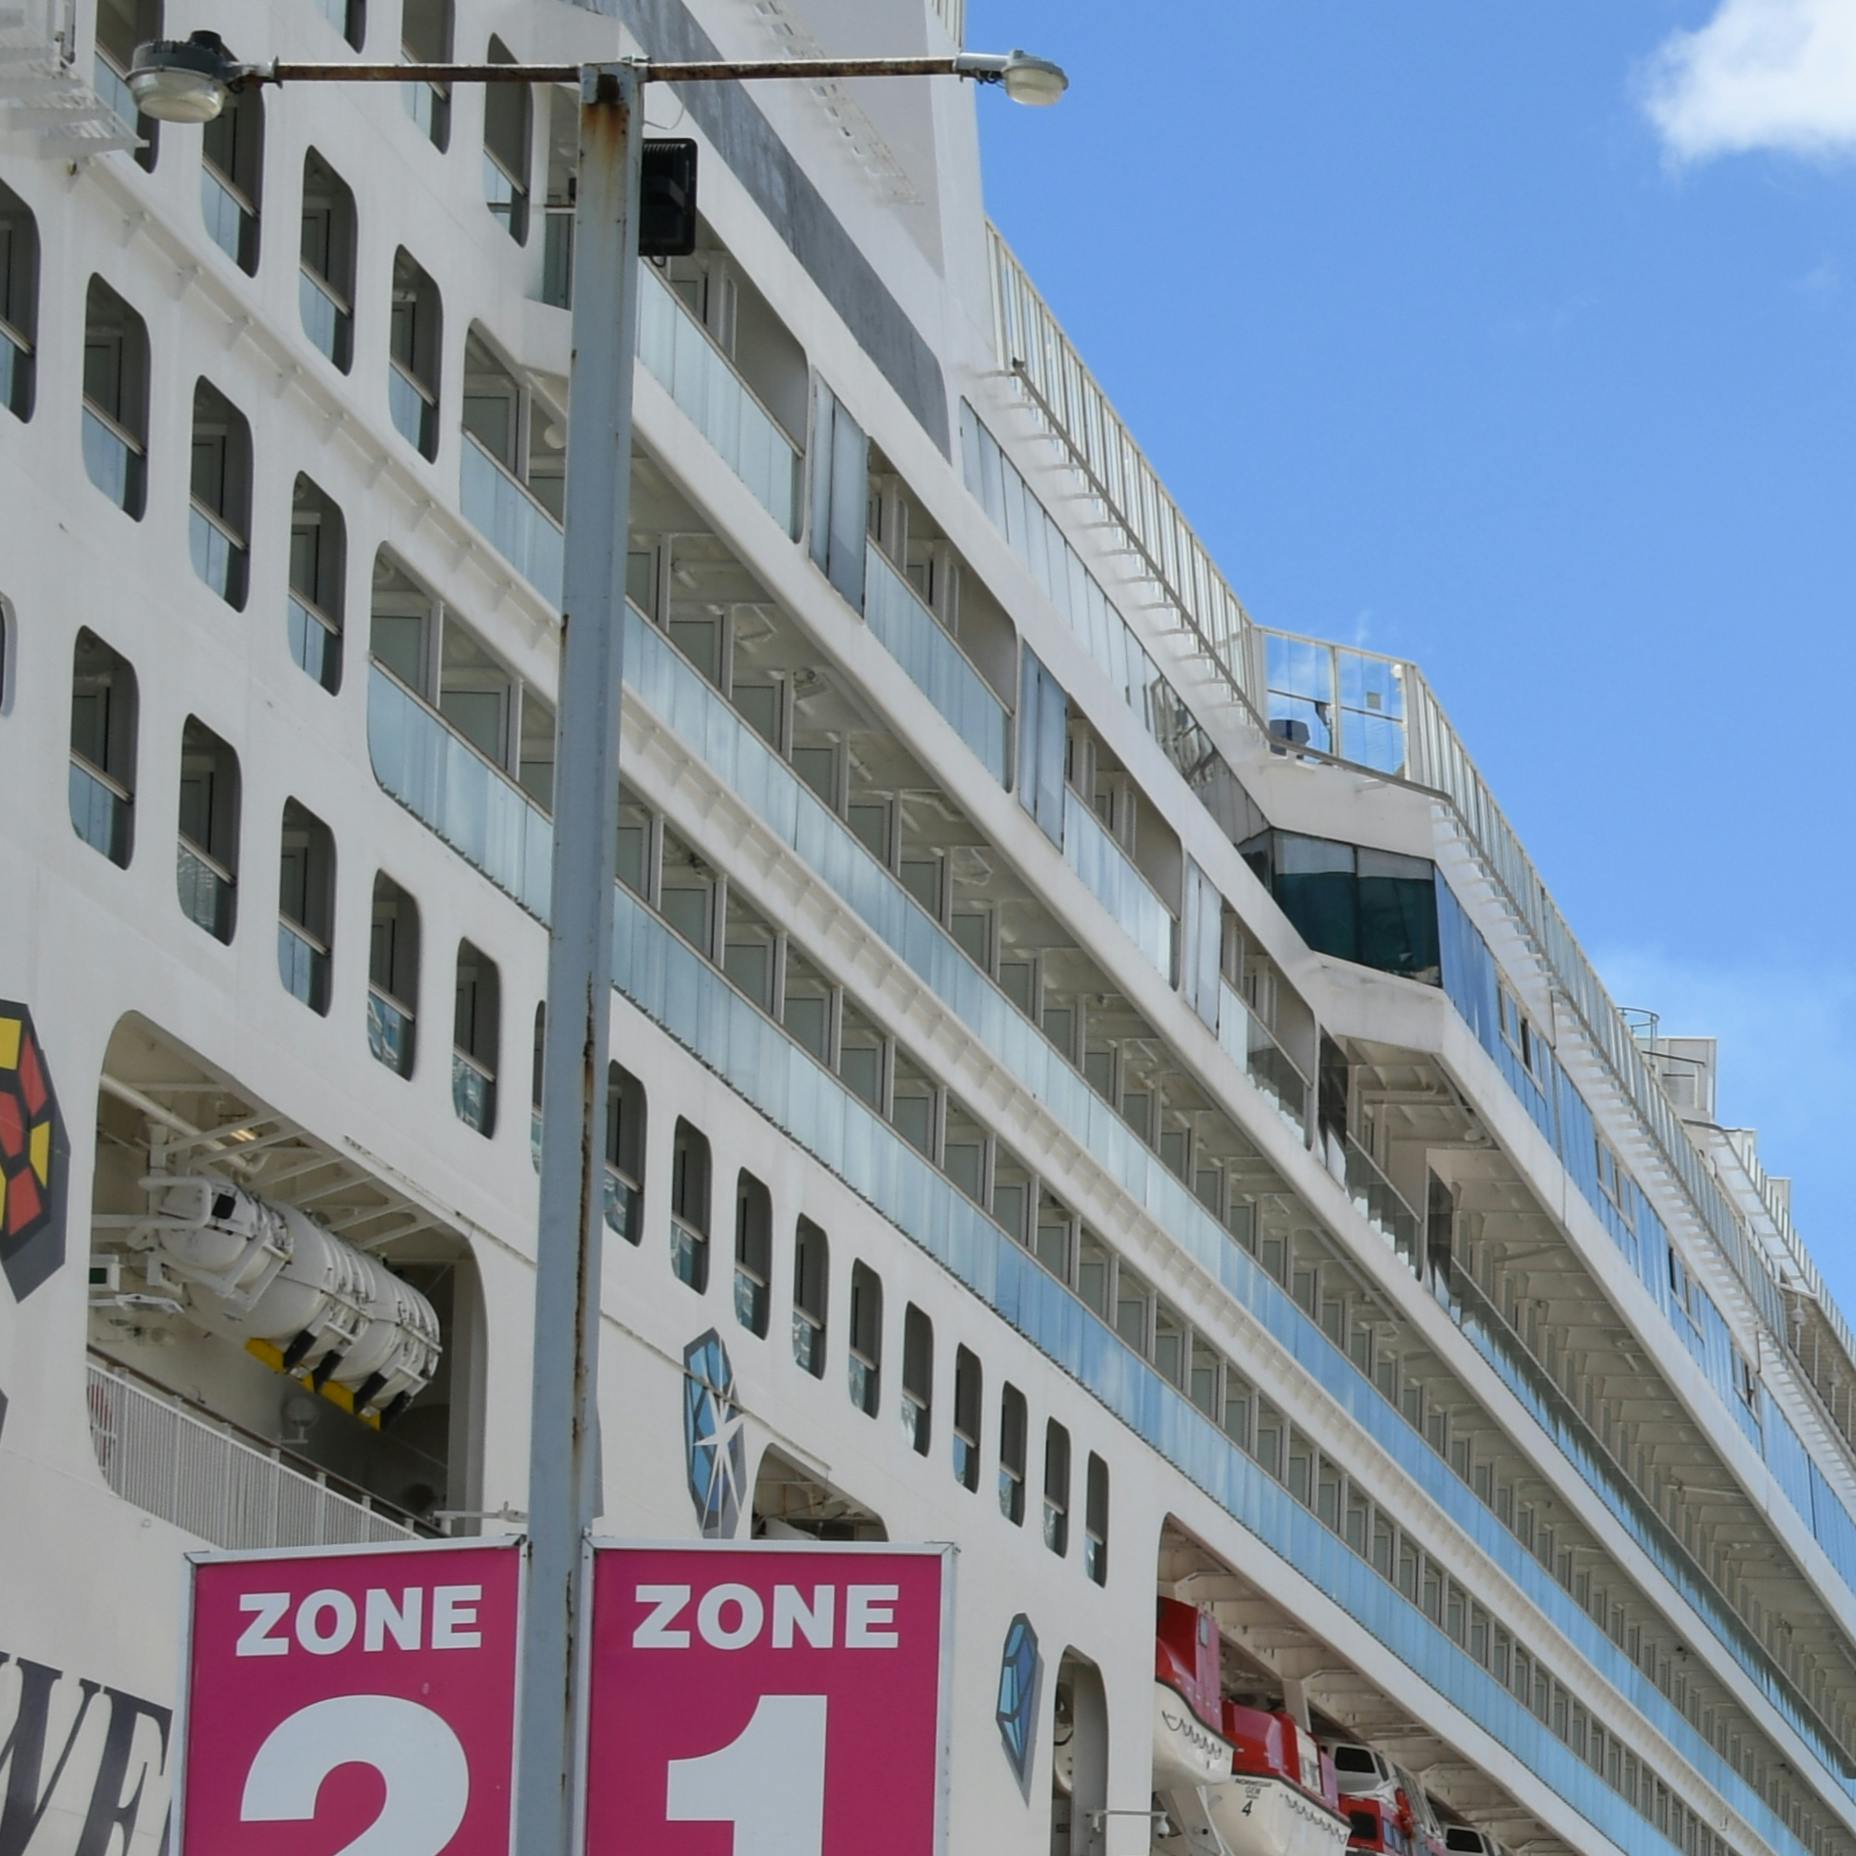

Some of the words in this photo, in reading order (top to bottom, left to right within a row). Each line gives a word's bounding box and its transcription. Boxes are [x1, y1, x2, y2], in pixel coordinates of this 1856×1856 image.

[236, 1584, 482, 1657] ZONE
[633, 1583, 899, 1650] ZONE
[1241, 1799, 1253, 1817] 4
